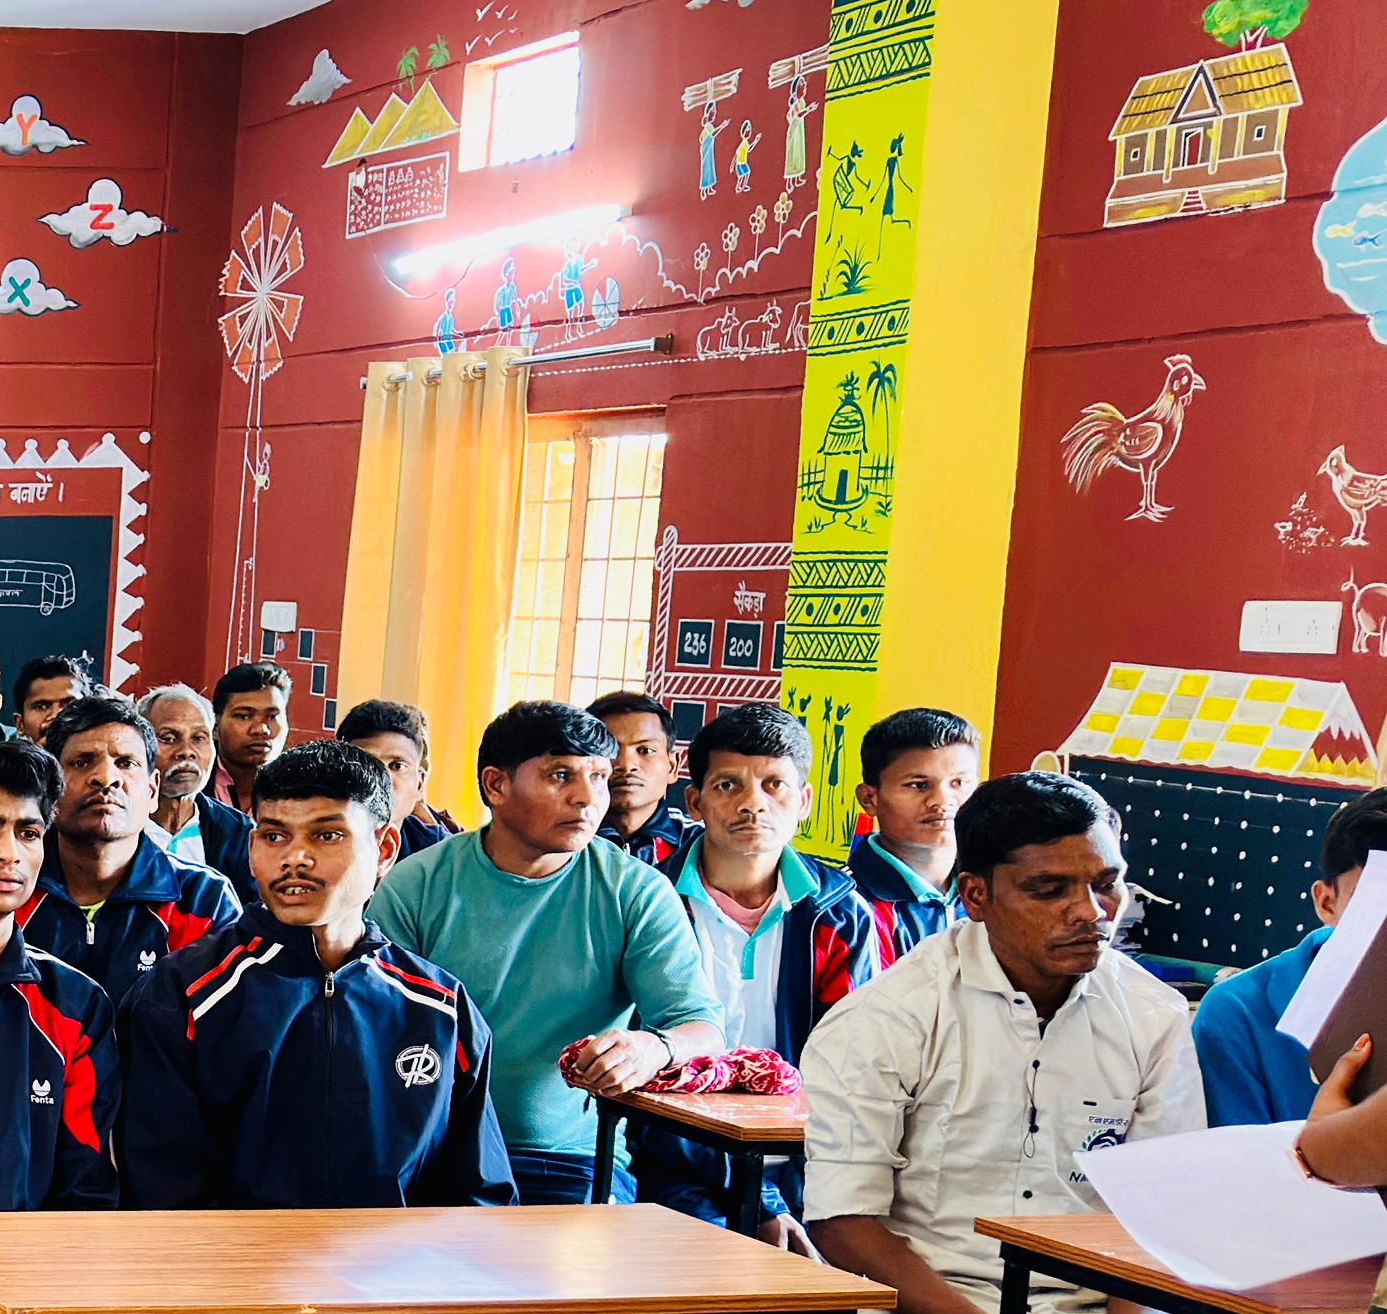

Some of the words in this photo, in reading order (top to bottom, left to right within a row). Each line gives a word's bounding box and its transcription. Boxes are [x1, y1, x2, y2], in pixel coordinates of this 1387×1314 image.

[16, 114, 38, 146] Y
[90, 203, 115, 231] Z
[7, 276, 31, 307] X
[683, 632, 707, 656] 236
[729, 637, 753, 657] 200
